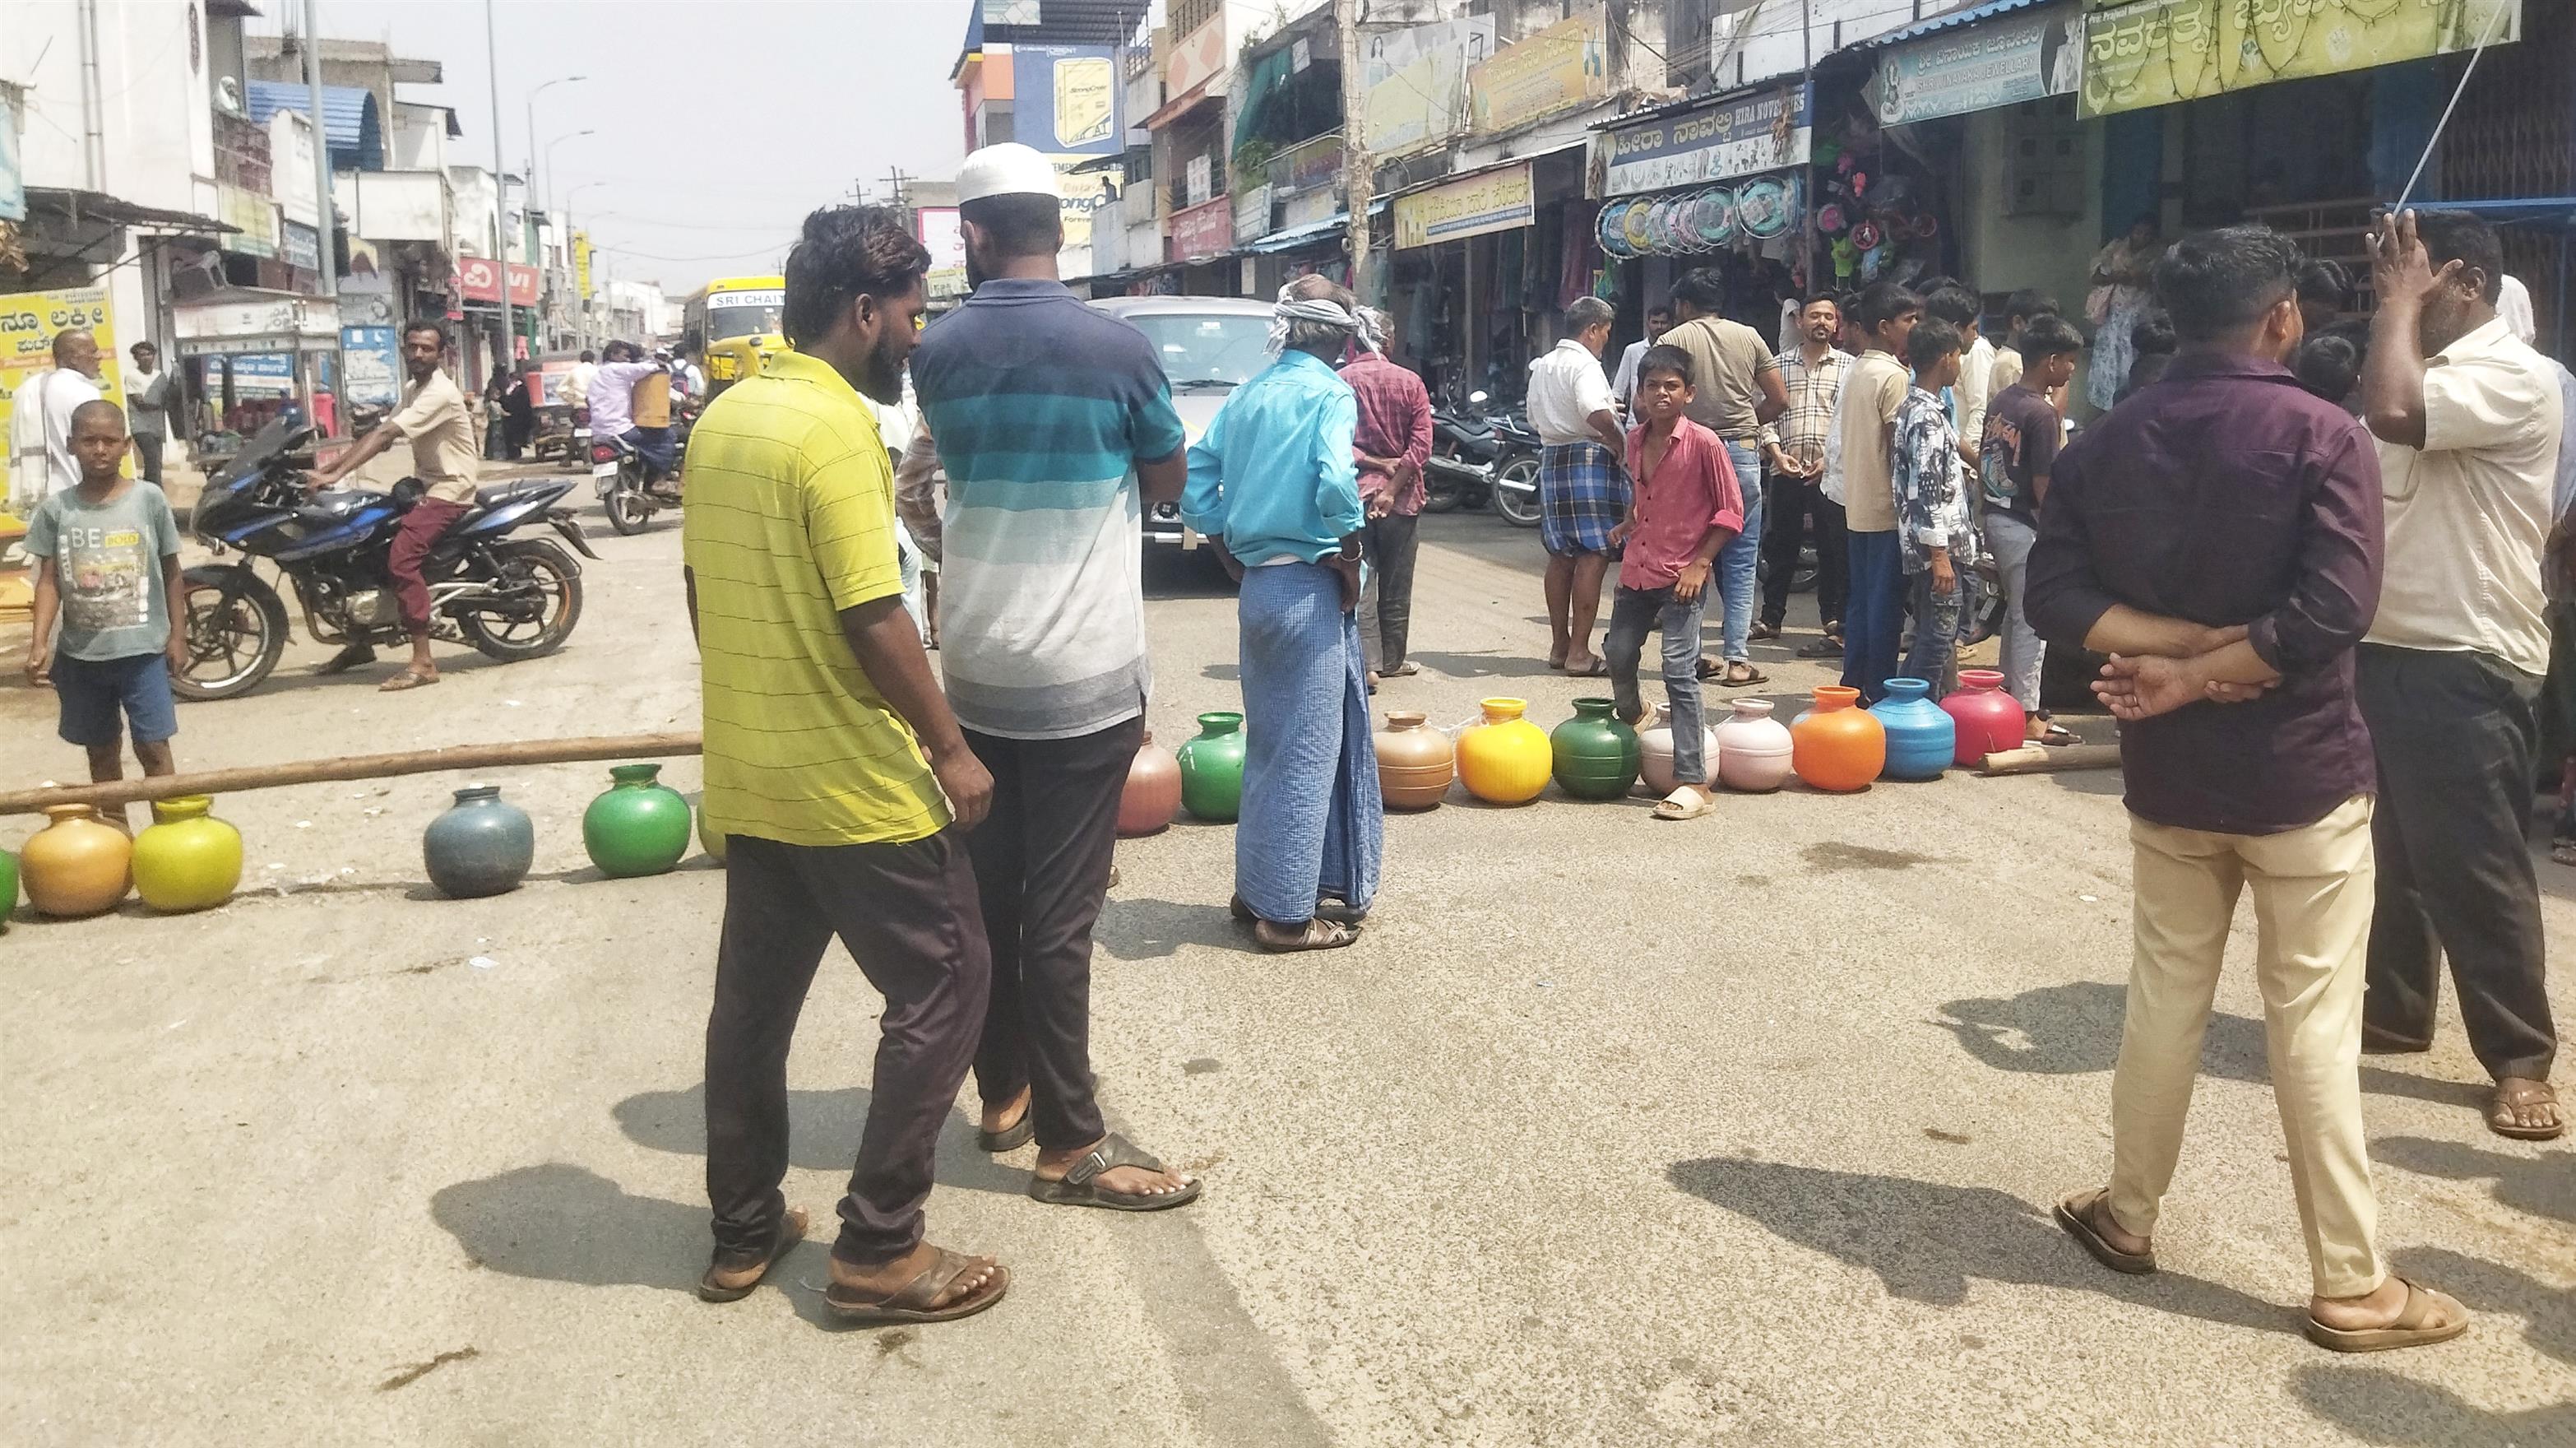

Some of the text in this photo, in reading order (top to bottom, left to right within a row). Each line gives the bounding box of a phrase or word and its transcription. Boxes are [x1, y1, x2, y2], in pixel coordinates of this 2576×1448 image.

[1615, 129, 1664, 155] ಹೀರಾ
[716, 295, 739, 307] SRI
[71, 527, 101, 549] BE
